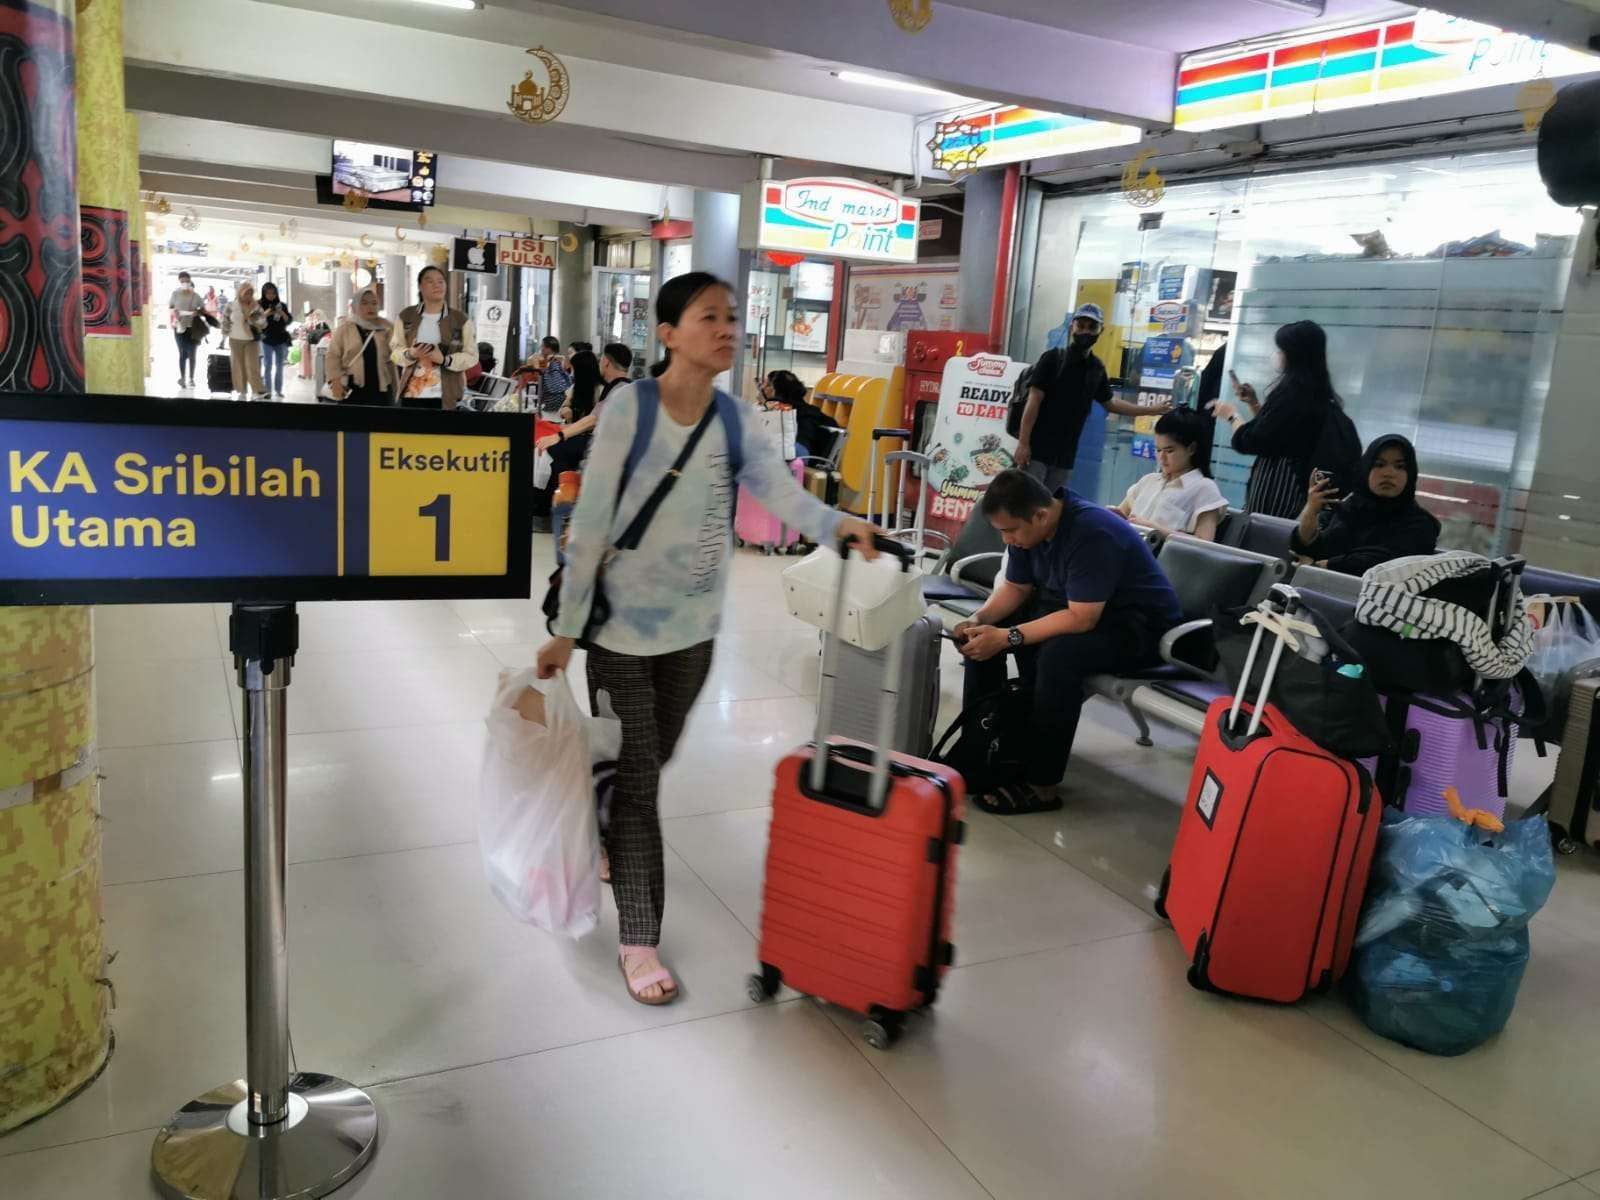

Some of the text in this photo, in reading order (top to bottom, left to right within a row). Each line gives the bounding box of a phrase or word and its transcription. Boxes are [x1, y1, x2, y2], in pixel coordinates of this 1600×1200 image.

[513, 239, 545, 253] ISI
[830, 223, 893, 253] Point
[500, 251, 554, 266] PULSA
[960, 386, 1012, 404] READY
[958, 402, 1008, 419] TO EAT
[379, 447, 511, 473] Eksekutif
[9, 450, 321, 497] KA Sribilah
[11, 504, 196, 548] Utama
[418, 494, 451, 562] 1
